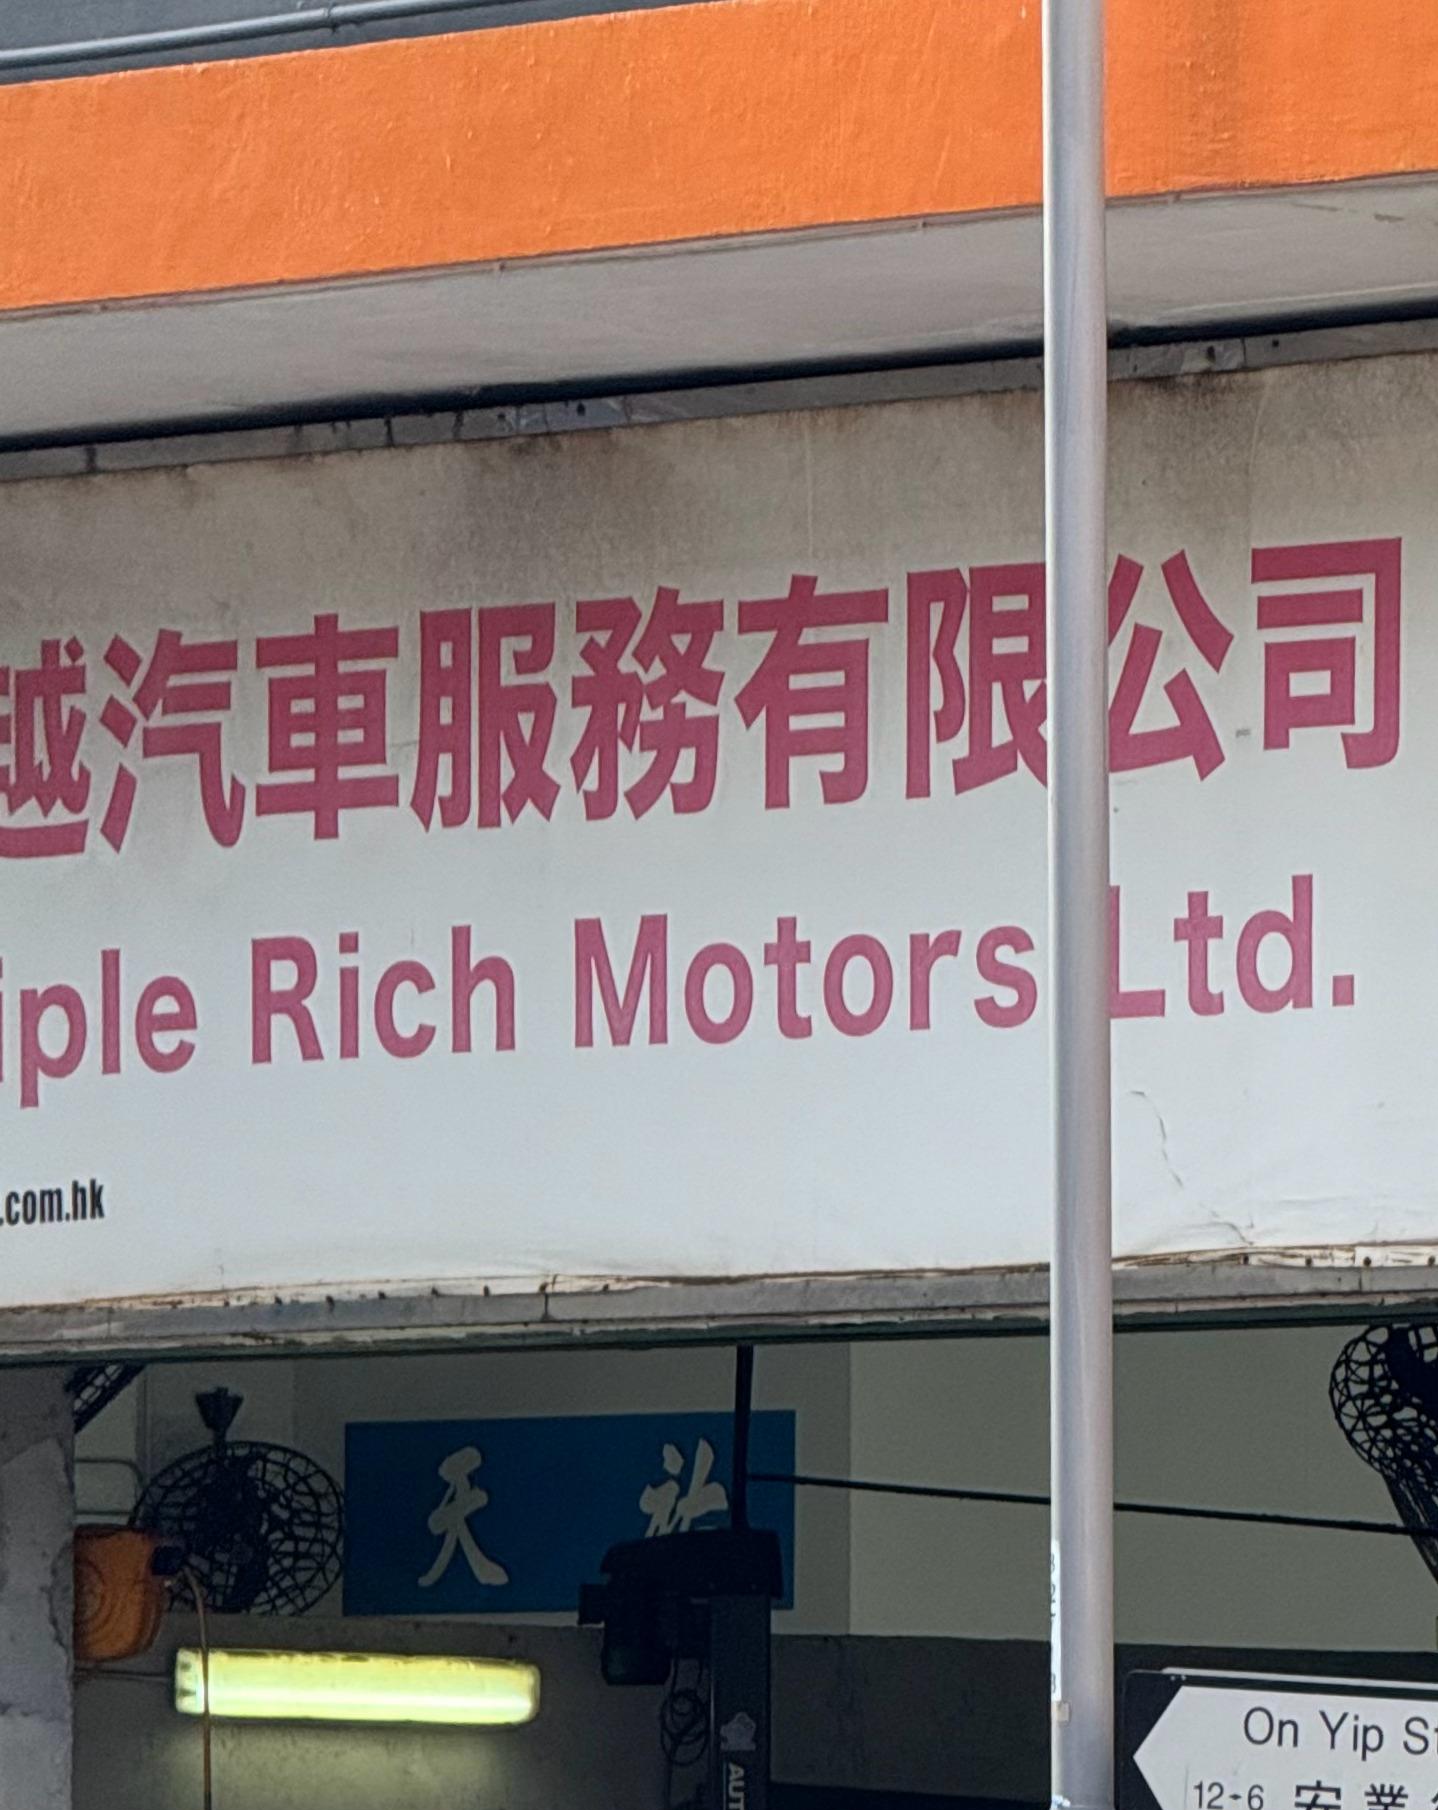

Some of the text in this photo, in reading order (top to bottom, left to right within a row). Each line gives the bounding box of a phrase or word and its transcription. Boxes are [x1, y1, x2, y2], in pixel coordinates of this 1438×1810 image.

[0, 873, 1356, 1109] ple Rich Motors Ltd.
[1243, 1706, 1300, 1749] On
[1318, 1709, 1385, 1762] Yip
